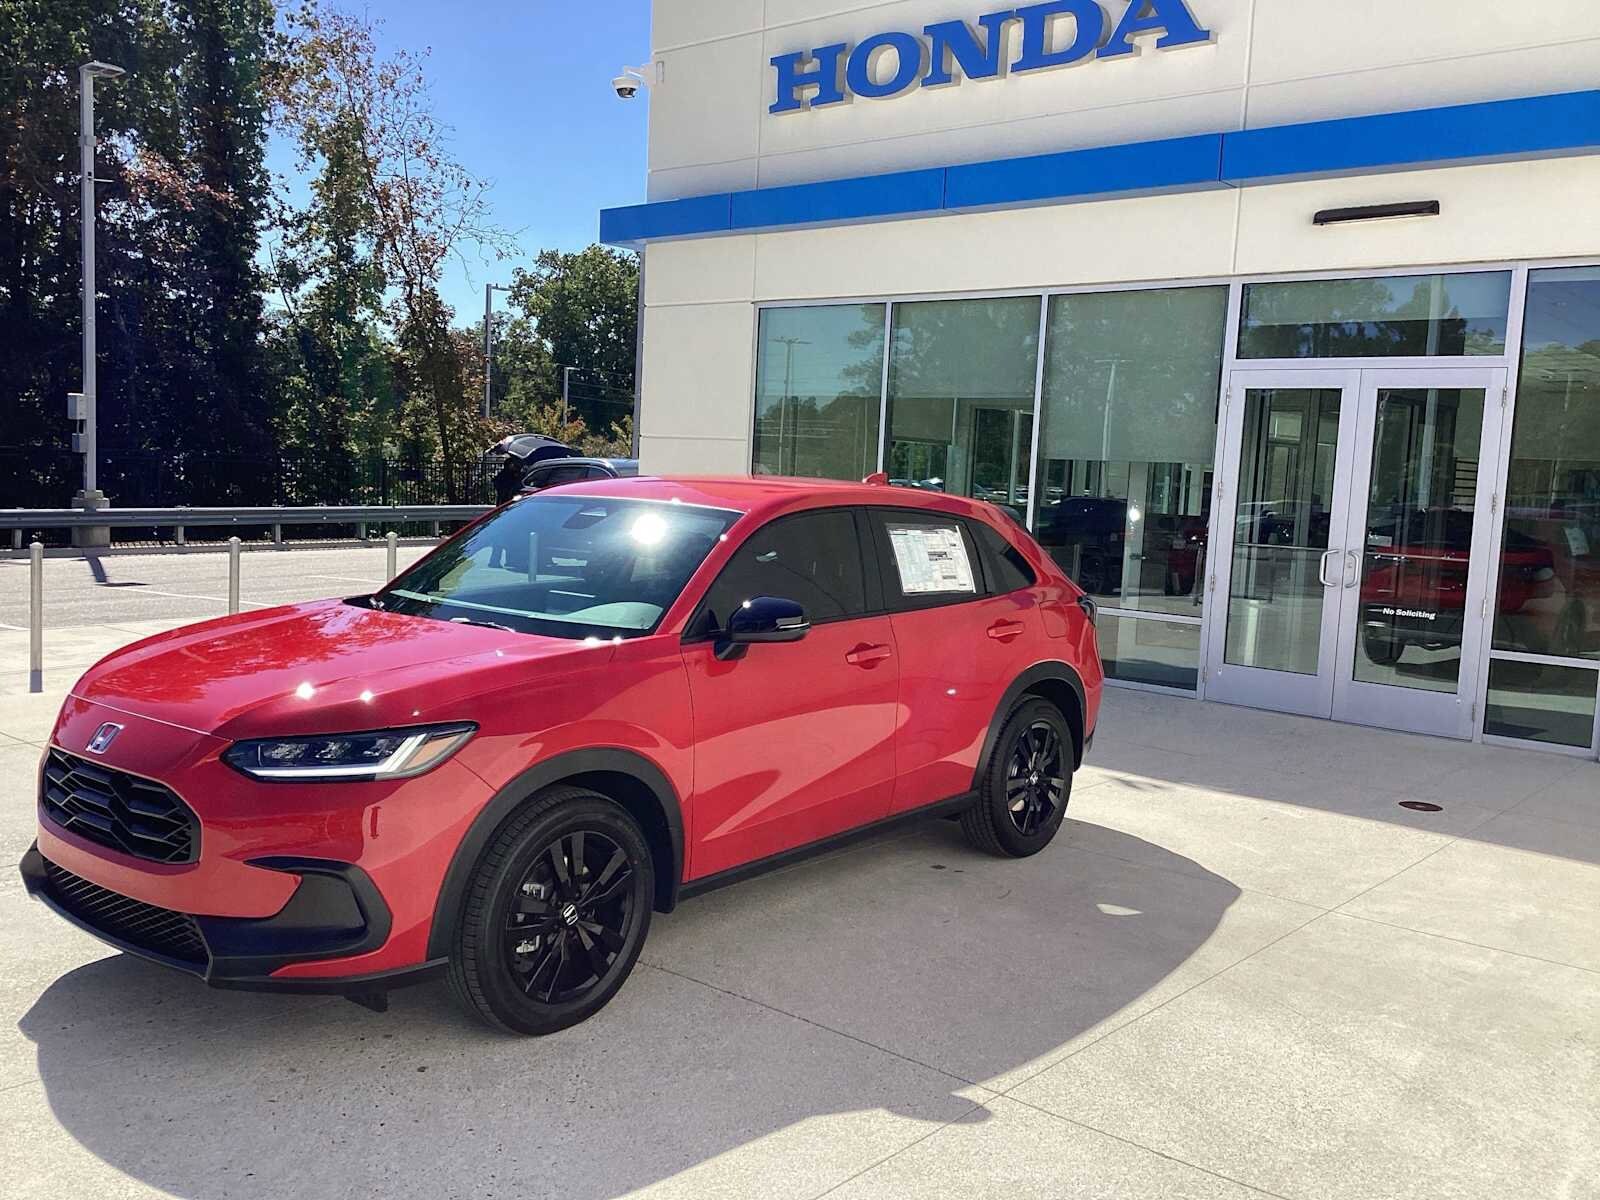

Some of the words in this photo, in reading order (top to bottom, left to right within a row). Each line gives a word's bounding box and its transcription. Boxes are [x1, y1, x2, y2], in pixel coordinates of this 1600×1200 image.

[769, 0, 1212, 114] HONDA
[1382, 607, 1395, 615] No
[1395, 608, 1436, 620] Soliciting
